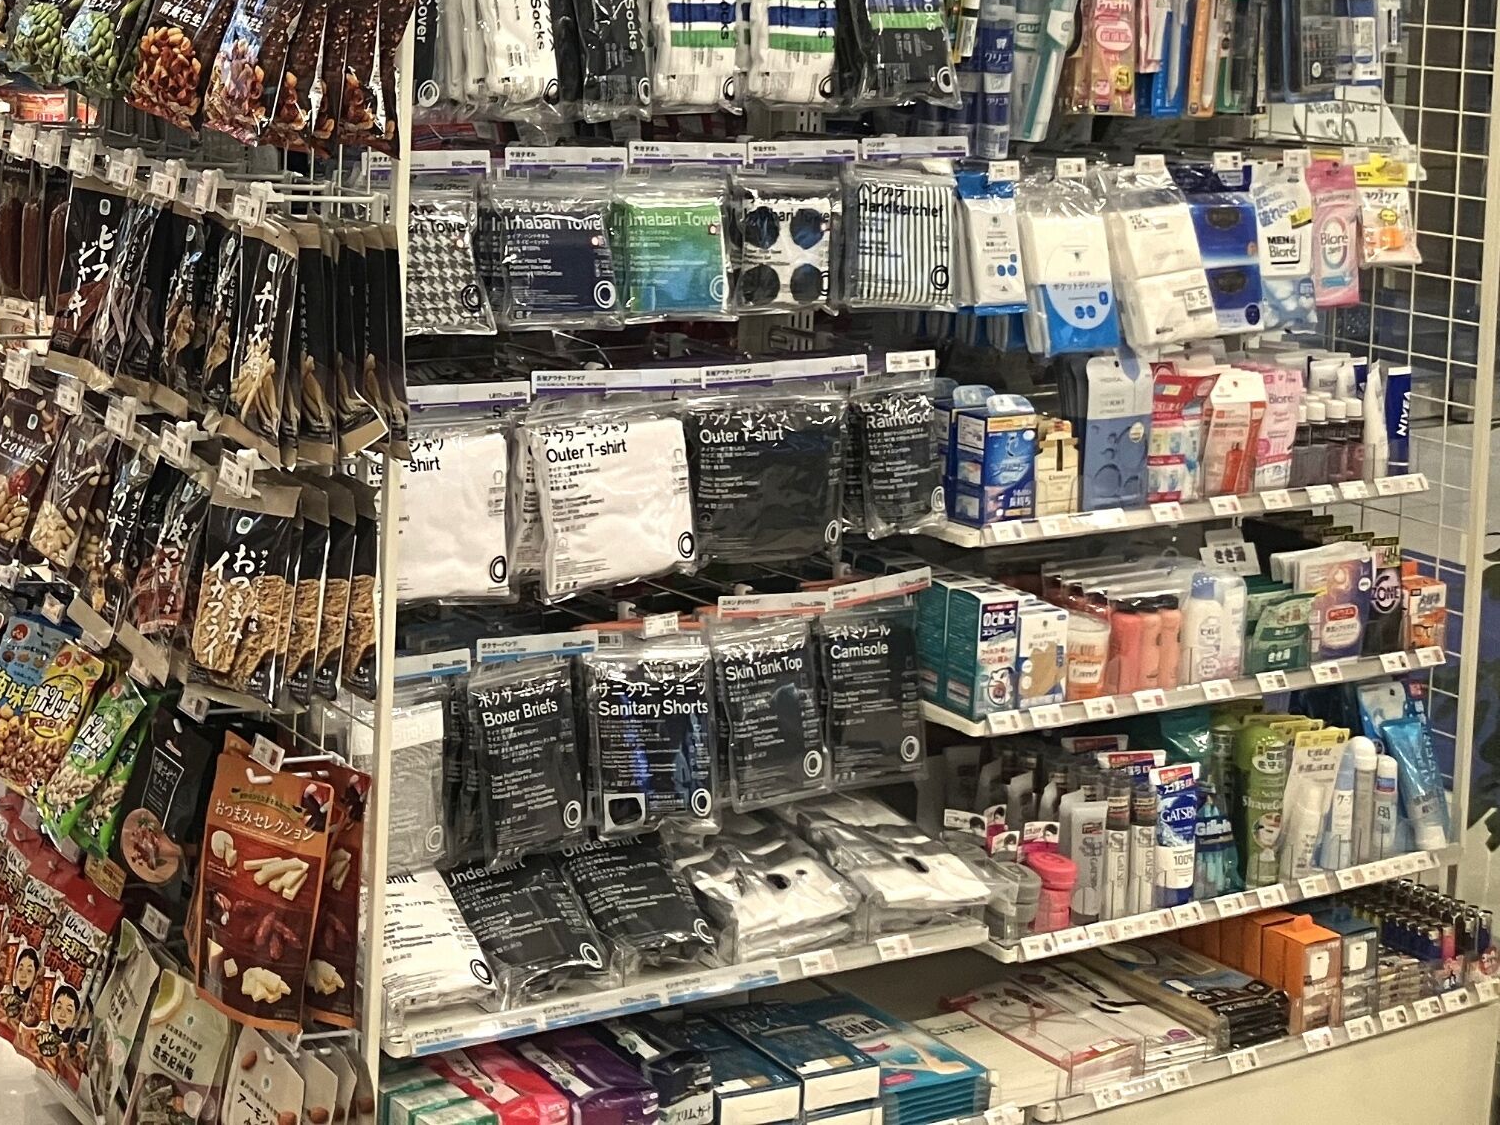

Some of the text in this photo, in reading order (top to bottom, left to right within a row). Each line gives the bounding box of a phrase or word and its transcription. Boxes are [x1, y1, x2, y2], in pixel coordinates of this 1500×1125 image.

[858, 199, 944, 218] Handkerchief
[92, 224, 118, 283] ビーフ
[68, 241, 100, 332] ジャーキー
[1396, 390, 1412, 437] NIVEA
[699, 426, 784, 444] Outer T-shirt
[546, 438, 627, 463] Outer T-shirt
[202, 550, 230, 667] イカフライ
[223, 543, 256, 646] おつまみ
[830, 640, 890, 660] Camisole
[725, 657, 803, 682] Skin Tank Top
[482, 698, 559, 727] Boxer Briefs
[598, 699, 709, 718] Sanitary Shorts
[215, 799, 316, 842] おつまみセレクション
[158, 1033, 198, 1065] おしゃぶり
